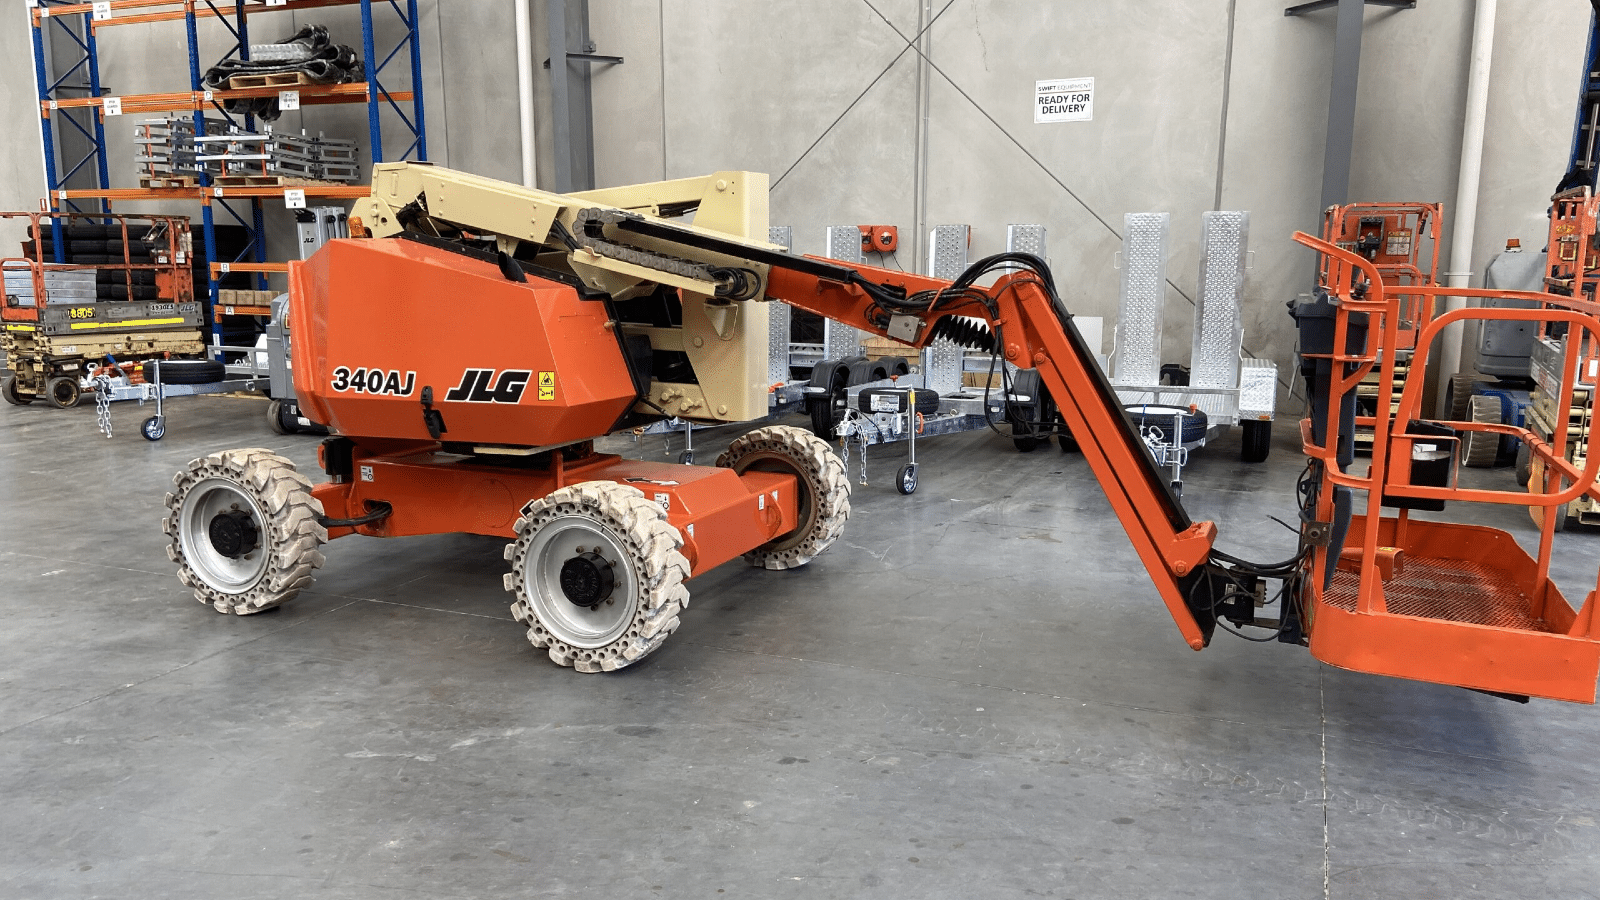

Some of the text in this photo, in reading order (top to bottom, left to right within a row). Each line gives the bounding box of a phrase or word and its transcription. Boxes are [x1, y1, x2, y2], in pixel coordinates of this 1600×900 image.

[51, 101, 57, 109] D
[1038, 94, 1090, 105] READY FOR
[1042, 104, 1086, 114] DELIVERY
[331, 366, 417, 397] 340AJ
[444, 368, 533, 405] JLG
